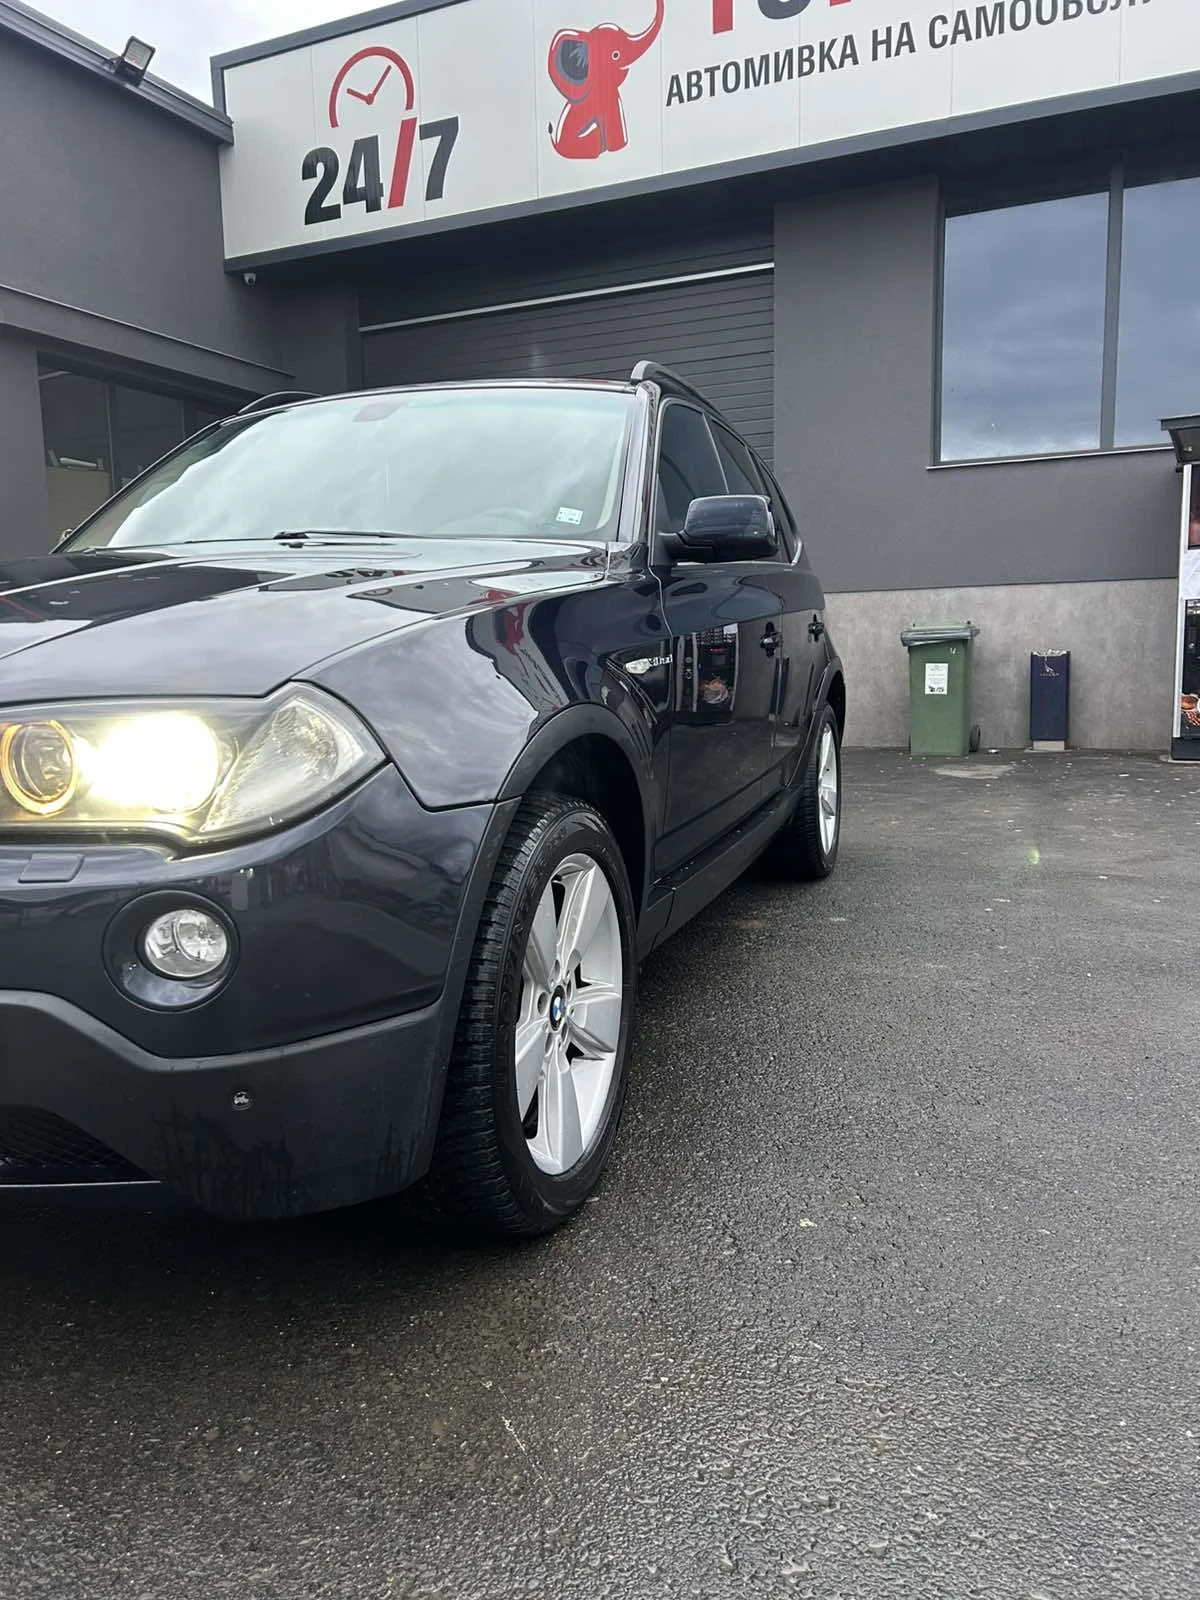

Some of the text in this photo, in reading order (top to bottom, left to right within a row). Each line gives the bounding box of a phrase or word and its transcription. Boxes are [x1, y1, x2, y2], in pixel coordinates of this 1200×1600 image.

[666, 34, 859, 106] АВТОМИВКА
[871, 22, 916, 61] НА
[301, 116, 459, 225] 24/7
